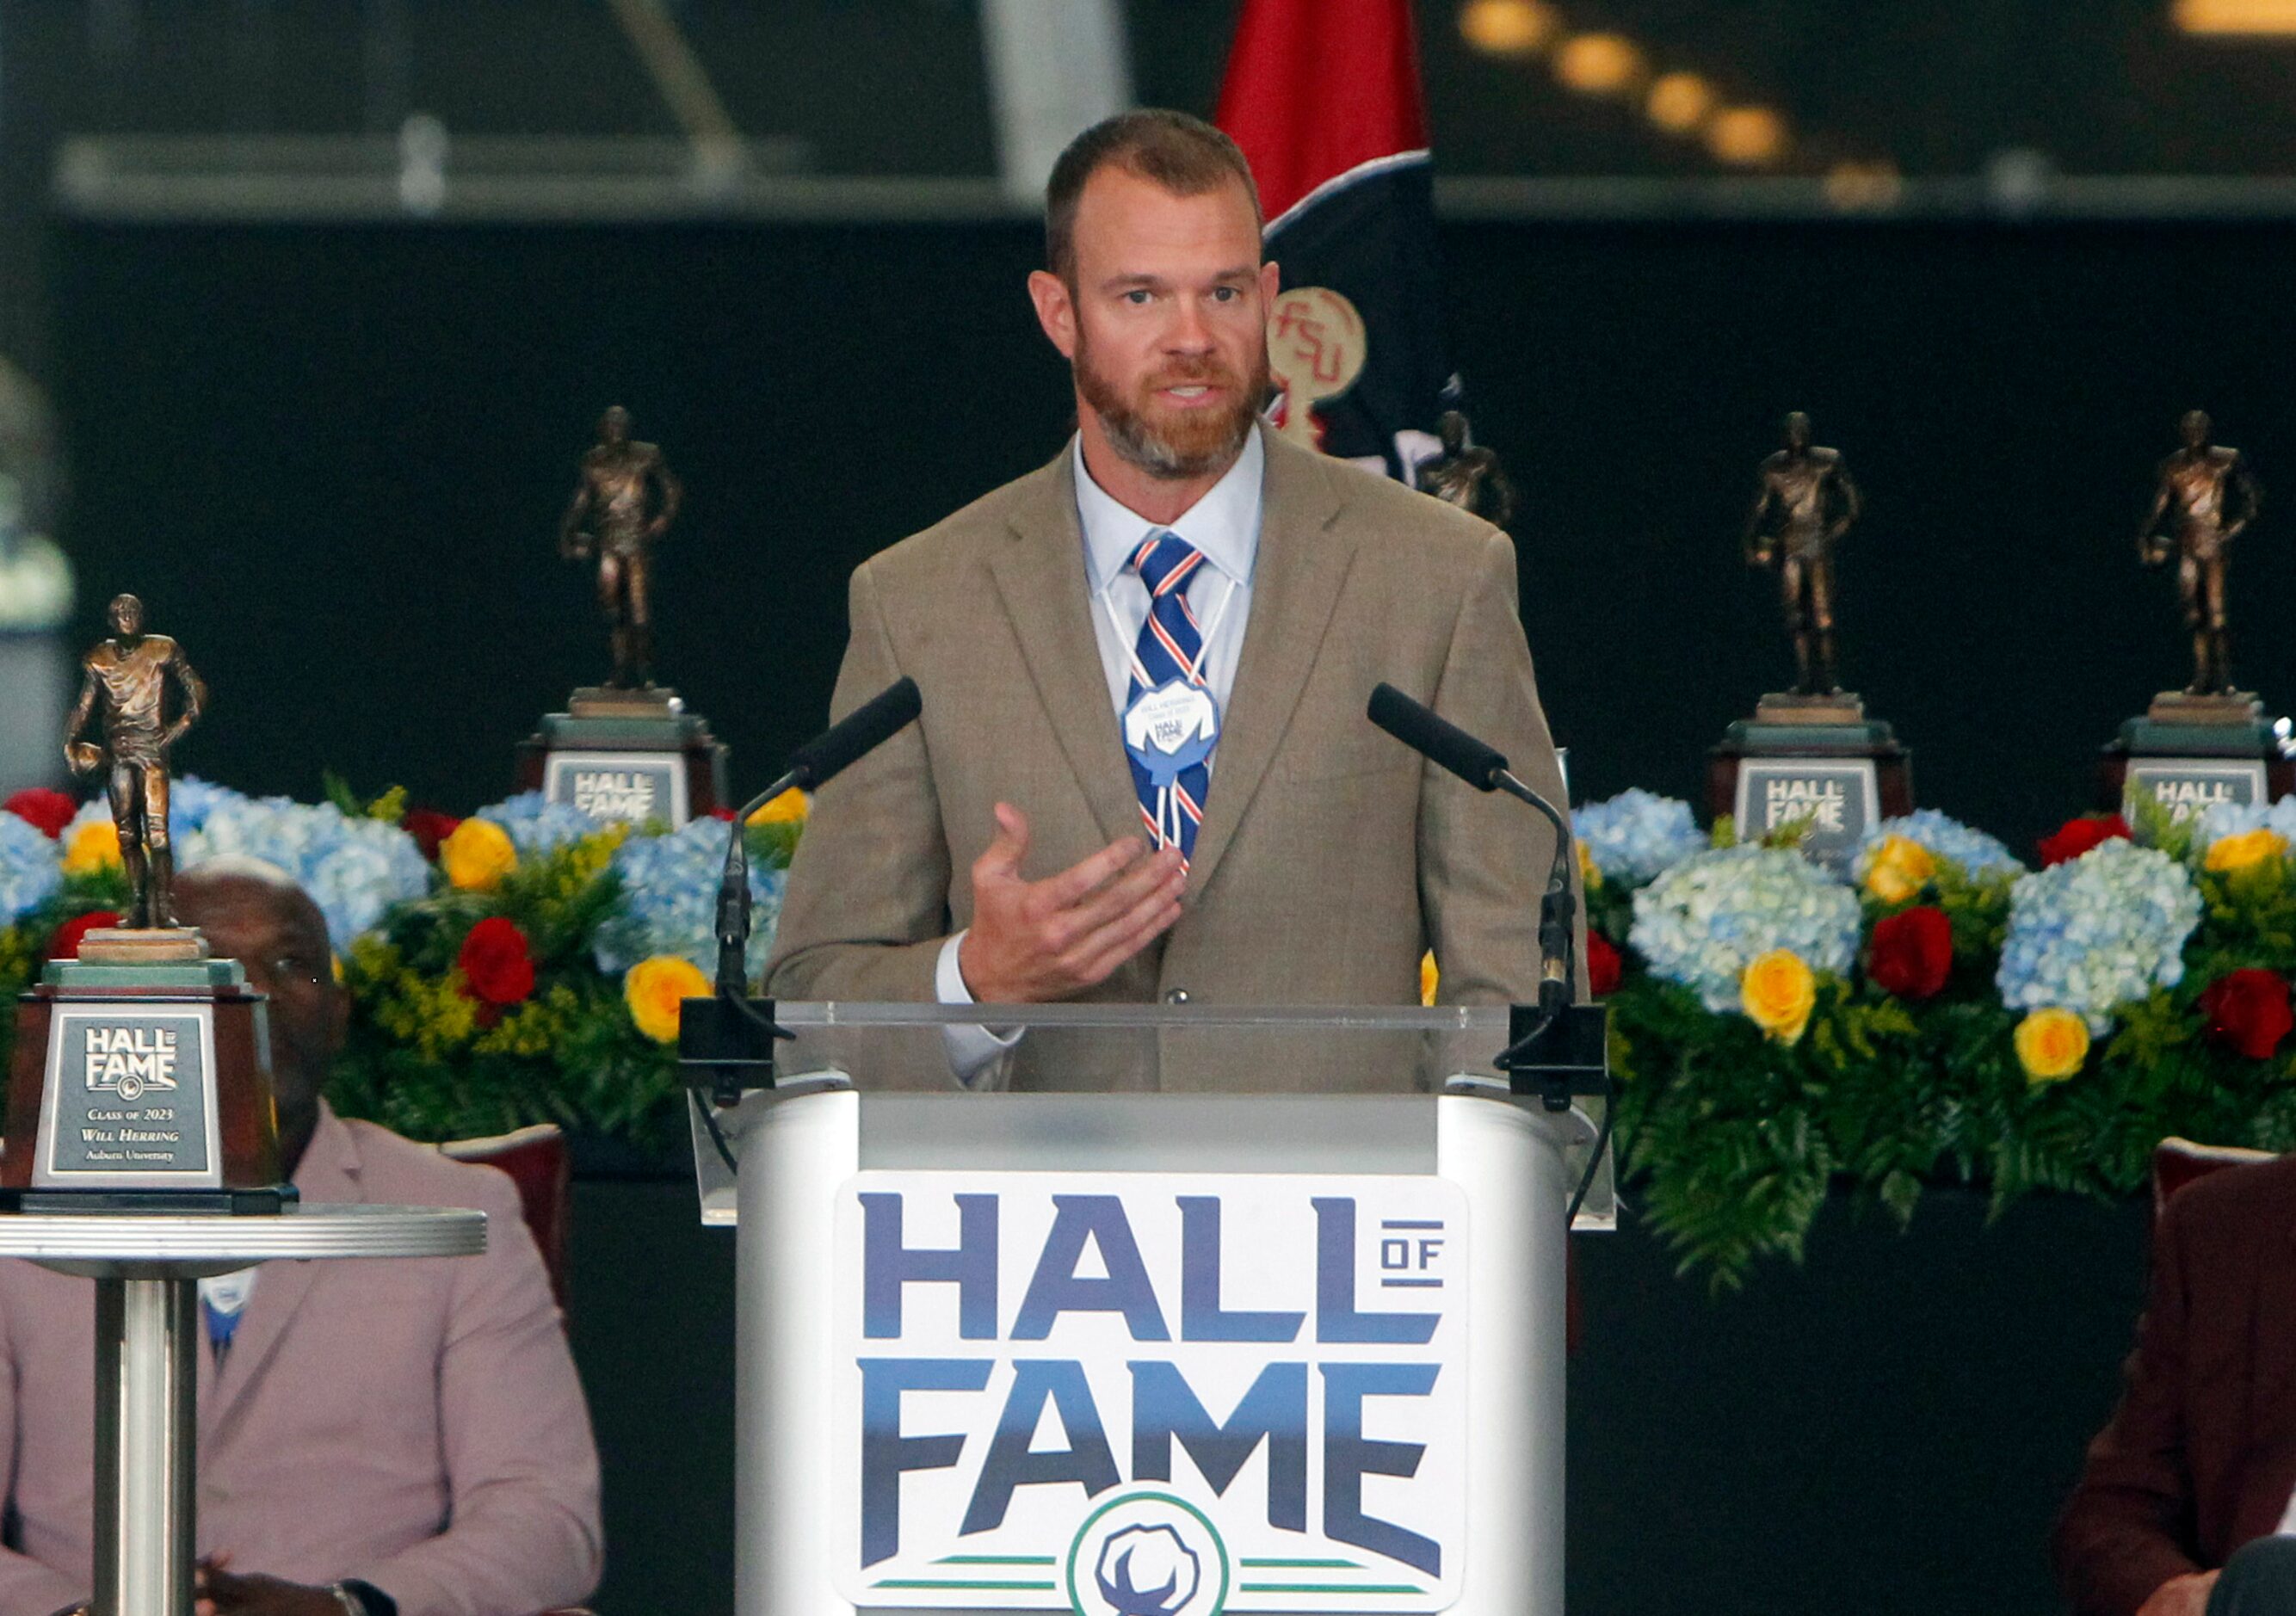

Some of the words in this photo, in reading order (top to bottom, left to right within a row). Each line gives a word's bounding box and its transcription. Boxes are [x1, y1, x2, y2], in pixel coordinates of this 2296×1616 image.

[1275, 301, 1343, 383] FSU
[574, 772, 654, 793] HALL
[1765, 779, 1844, 799] HALL
[2155, 780, 2231, 803] HALL
[85, 1027, 176, 1052] HALL
[85, 1052, 178, 1089] FAME
[144, 1107, 174, 1121] 2023
[86, 1150, 123, 1161] Auburn
[126, 1150, 174, 1163] University
[857, 1192, 1443, 1344] HALL
[1380, 1238, 1445, 1270] OF
[855, 1357, 1443, 1580] FAME
